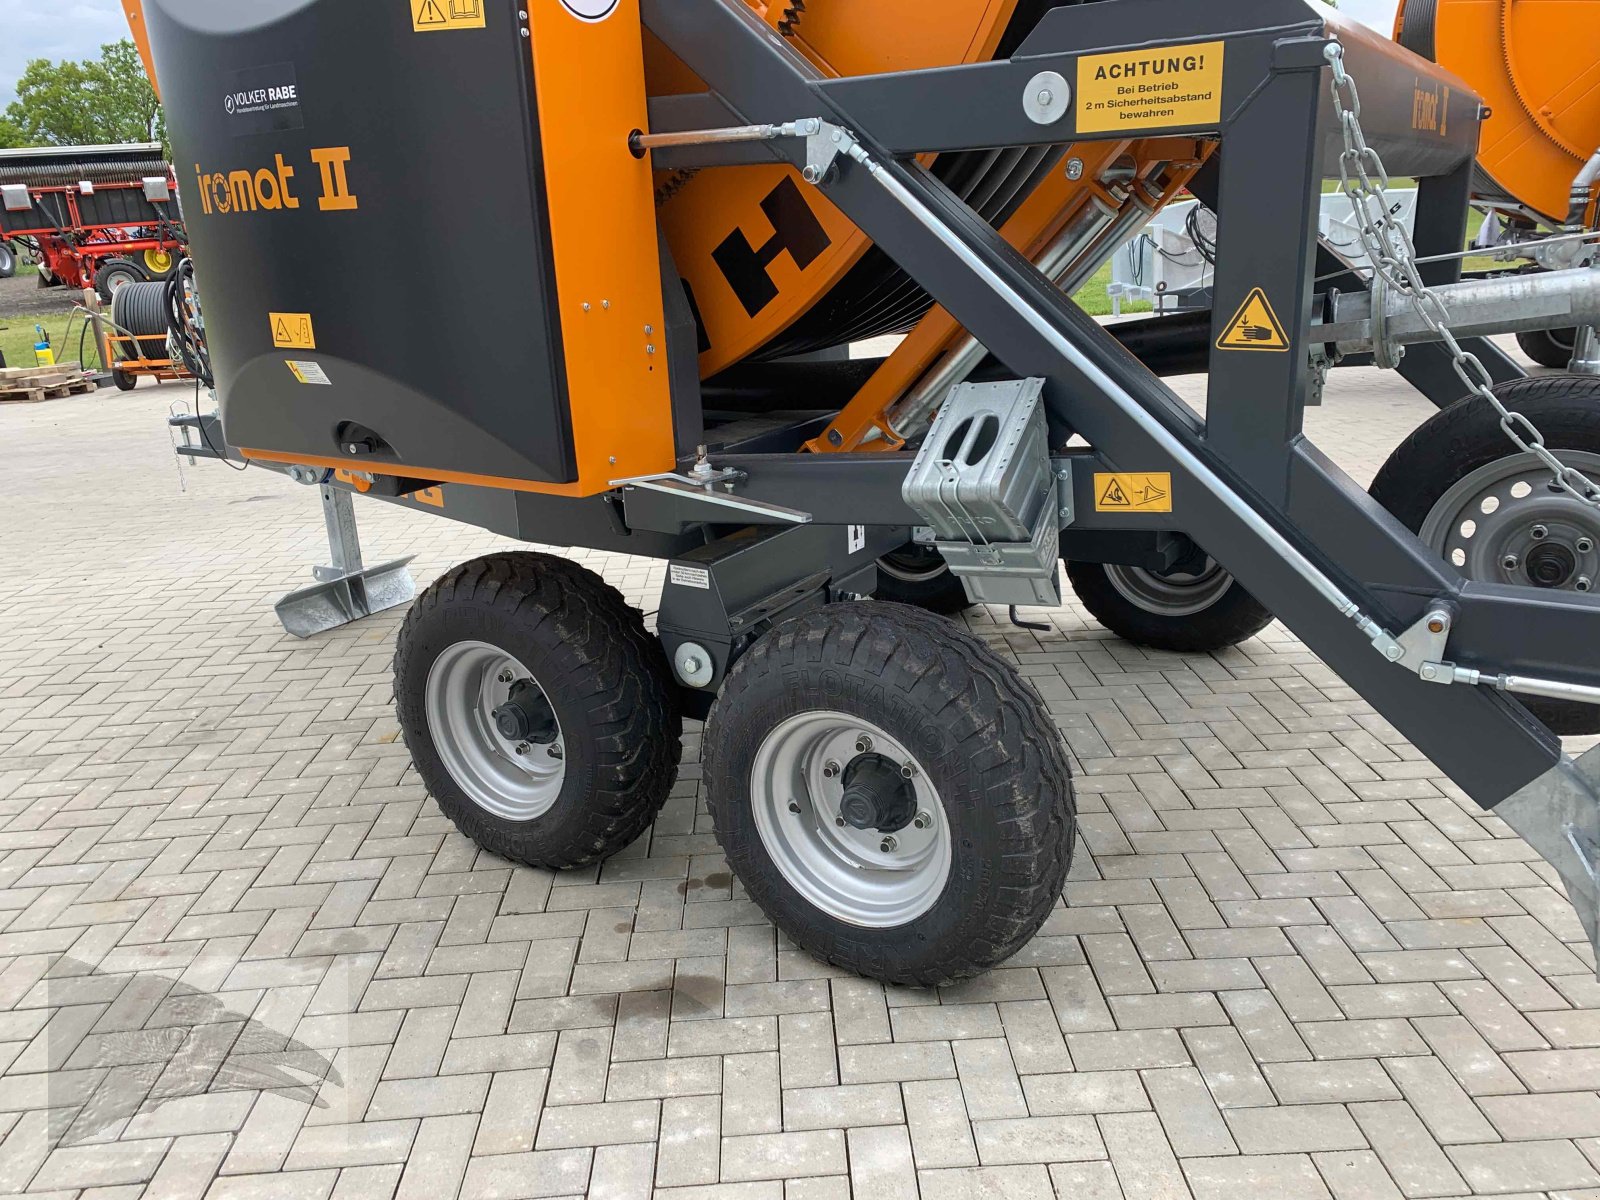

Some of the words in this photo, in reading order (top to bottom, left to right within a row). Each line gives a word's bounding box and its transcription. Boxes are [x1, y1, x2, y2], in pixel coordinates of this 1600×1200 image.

[1094, 55, 1204, 81] ACHTUNG!
[233, 89, 267, 106] VOLKER
[268, 85, 297, 101] RABE
[1117, 86, 1135, 95] Bei
[1138, 82, 1179, 93] Betrieb
[1086, 102, 1093, 110] 2
[1094, 102, 1105, 110] m
[1107, 91, 1212, 108] Sicherheitsabstand
[1119, 109, 1174, 120] bewahren
[195, 153, 300, 215] iromat
[310, 146, 359, 212] II
[782, 669, 968, 781] FLOTATION
